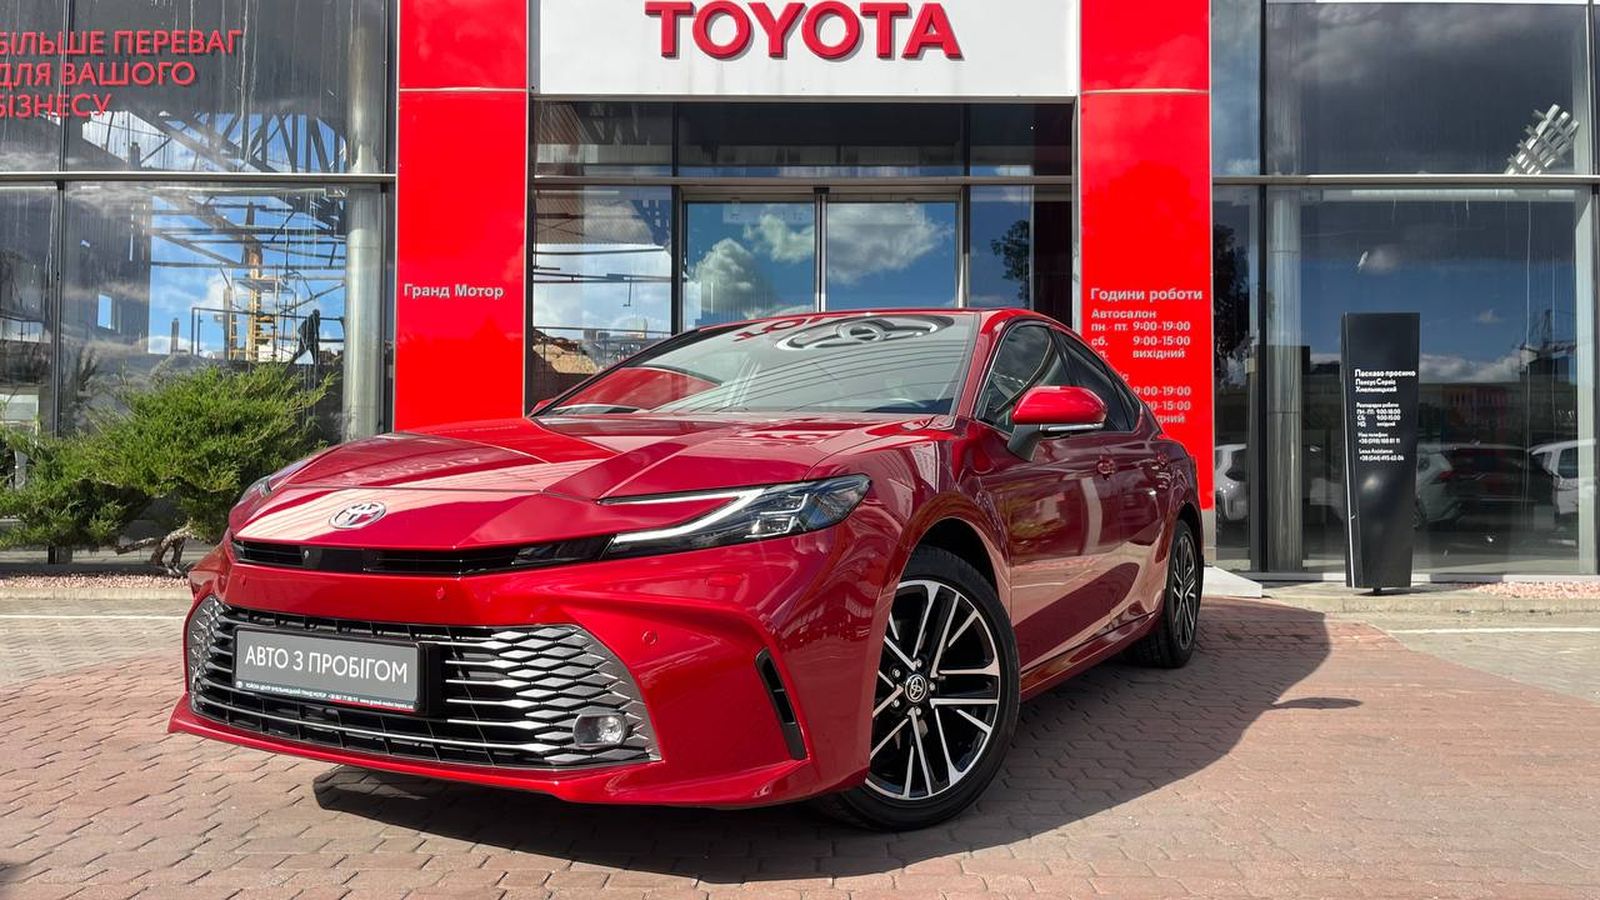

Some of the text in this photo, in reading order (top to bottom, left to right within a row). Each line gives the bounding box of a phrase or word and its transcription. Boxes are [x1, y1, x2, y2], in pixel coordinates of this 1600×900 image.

[645, 0, 964, 60] TOYOTA
[0, 30, 242, 55] БІЛЬШЕ ПЕРЕВАГ
[0, 61, 196, 90] ДЛЯ ВАШОГО
[403, 283, 504, 300] Гранд Мотор
[1090, 288, 1203, 302] Години роботи
[1091, 309, 1157, 319] Автосалон
[1132, 321, 1191, 331] 9:00-19:00
[1091, 336, 1191, 346] сб. 9:00-15:00
[1132, 348, 1186, 360] вихідний
[245, 645, 407, 684] АВТО З ПРОБІГОМ
